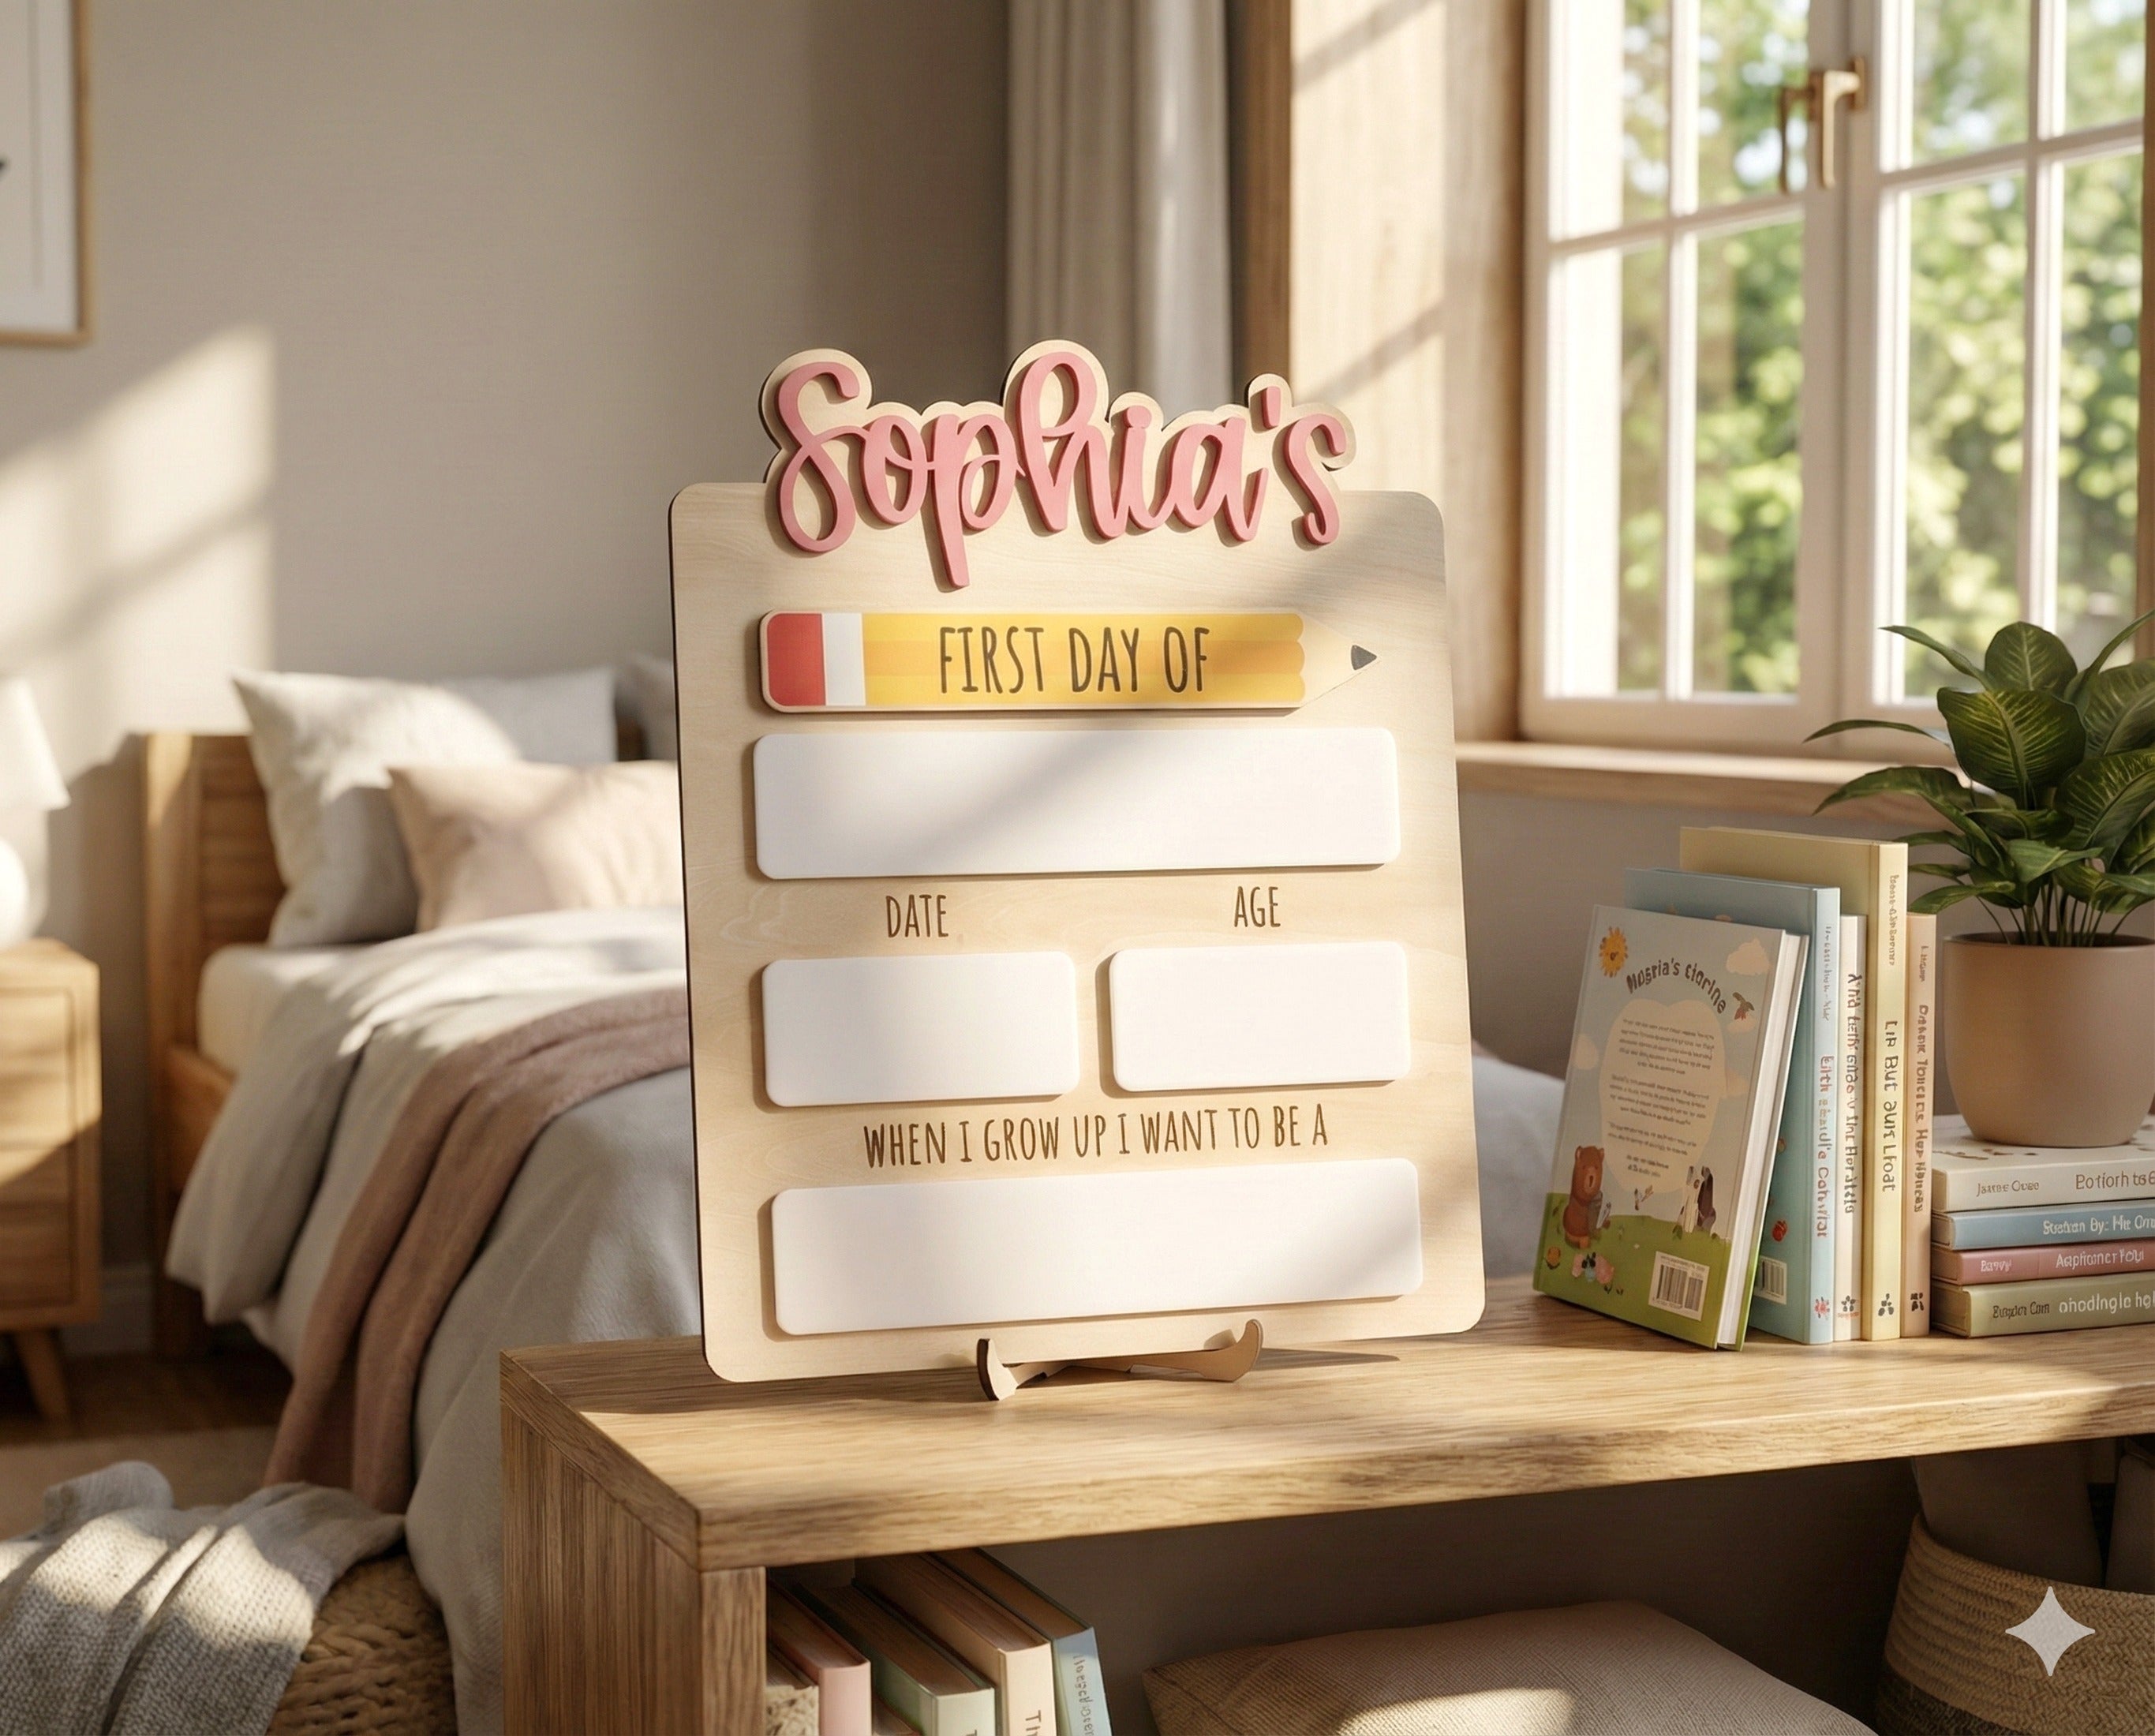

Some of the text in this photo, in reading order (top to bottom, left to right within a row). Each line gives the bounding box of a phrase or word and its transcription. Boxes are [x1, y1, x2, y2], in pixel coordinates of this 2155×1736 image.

[776, 351, 1348, 588] Sophia's
[939, 626, 1210, 694] FIRST DAY OF
[885, 893, 949, 938] DATE
[1233, 885, 1281, 929] AGE
[863, 1103, 1328, 1168] WHEN I GROW UP I WANT TO BE A
